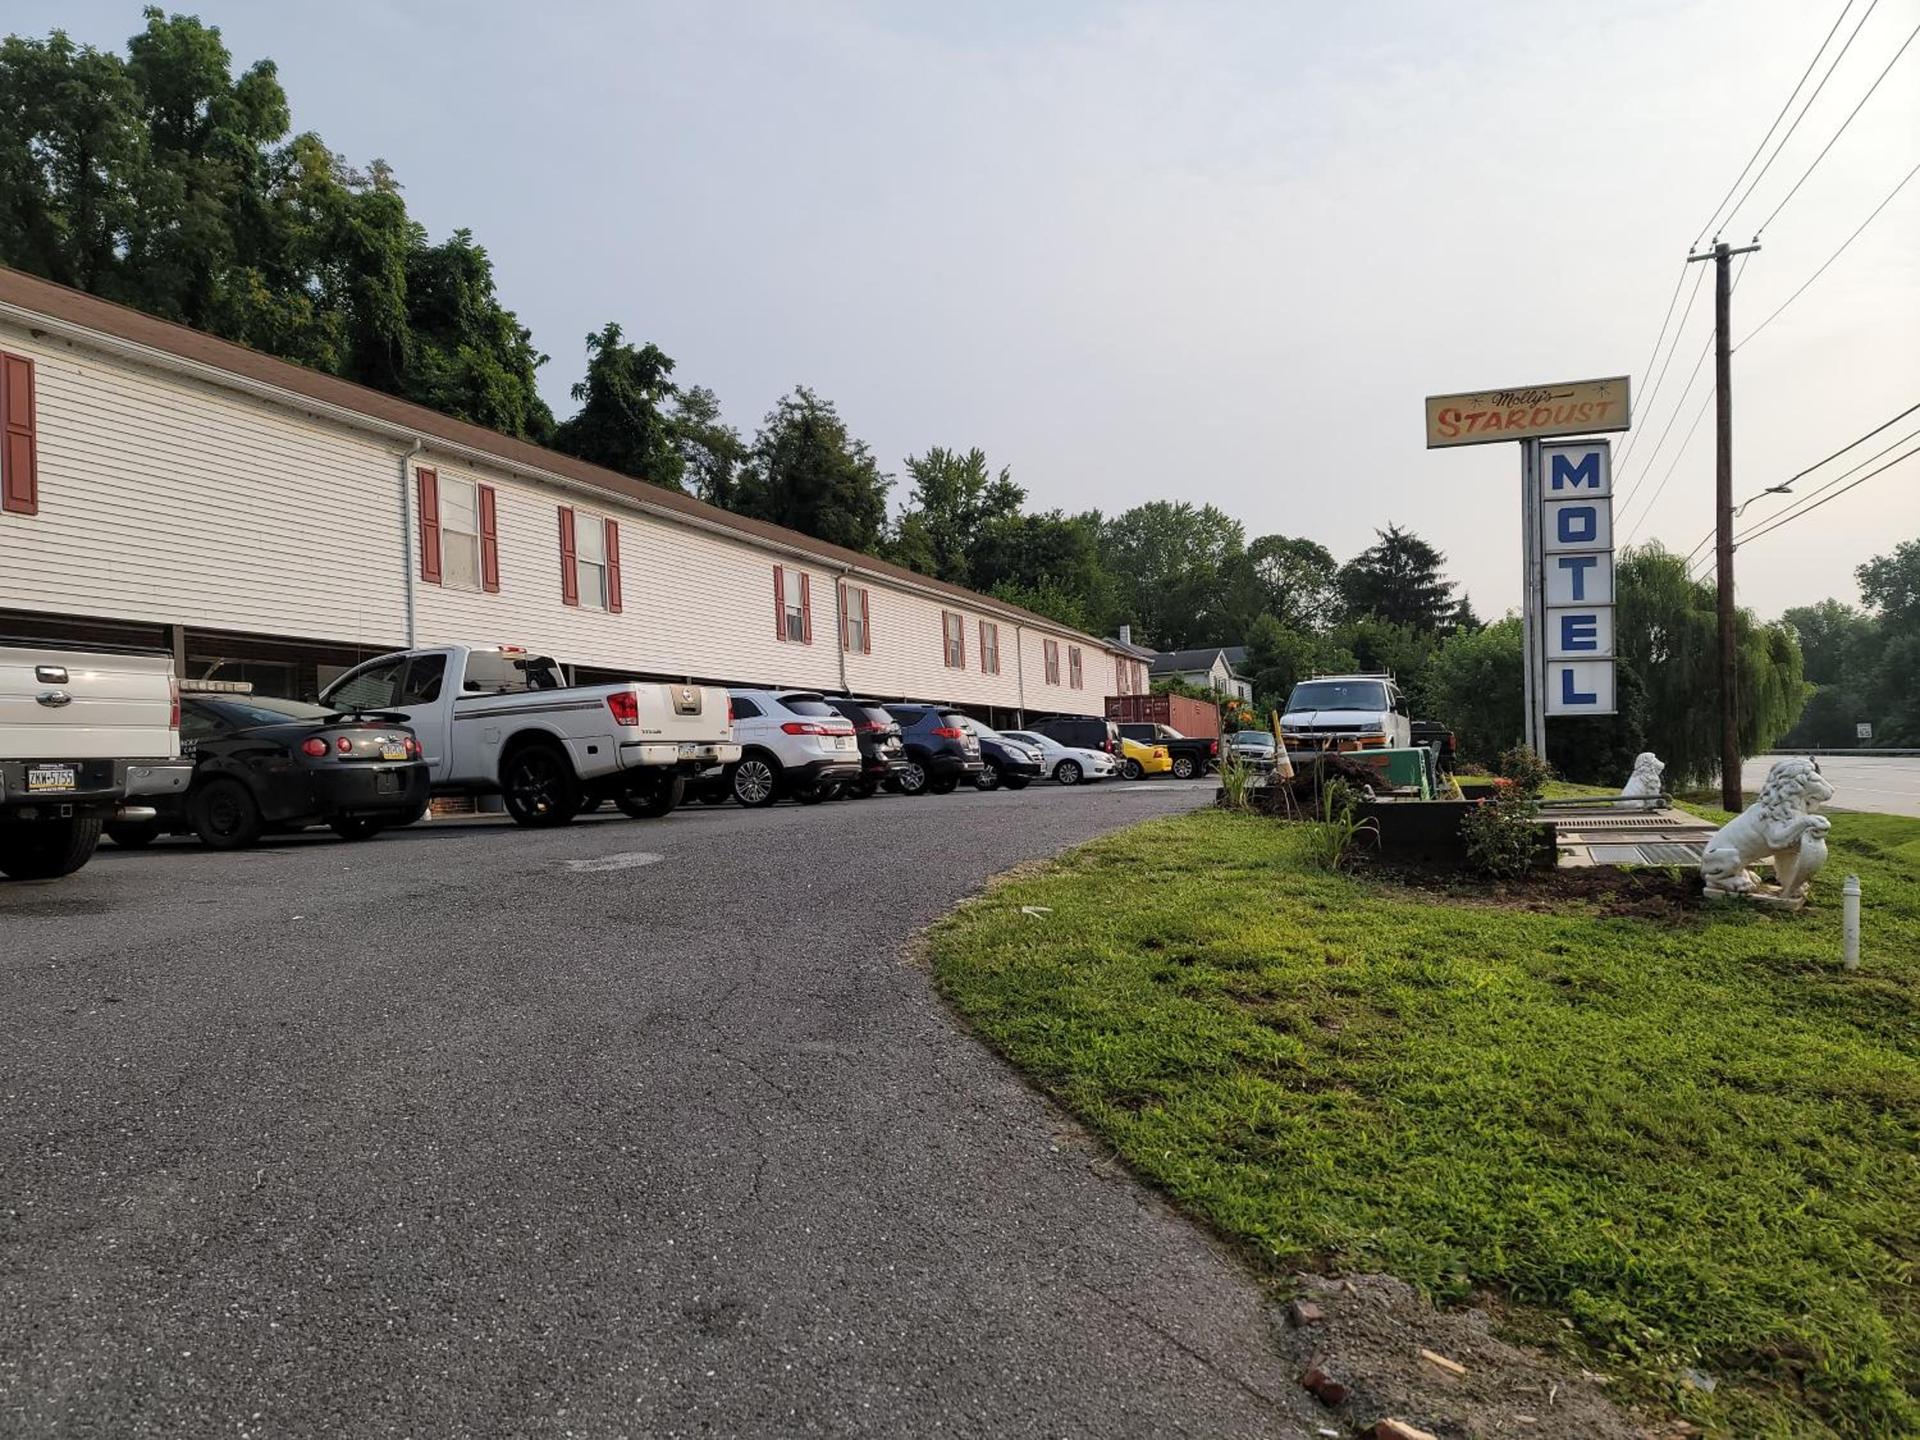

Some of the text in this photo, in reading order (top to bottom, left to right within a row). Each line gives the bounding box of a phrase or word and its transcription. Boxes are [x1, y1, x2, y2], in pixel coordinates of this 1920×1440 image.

[1492, 390, 1574, 408] Molly's
[1437, 401, 1614, 438] STARDUST
[1552, 452, 1600, 705] MOTEL
